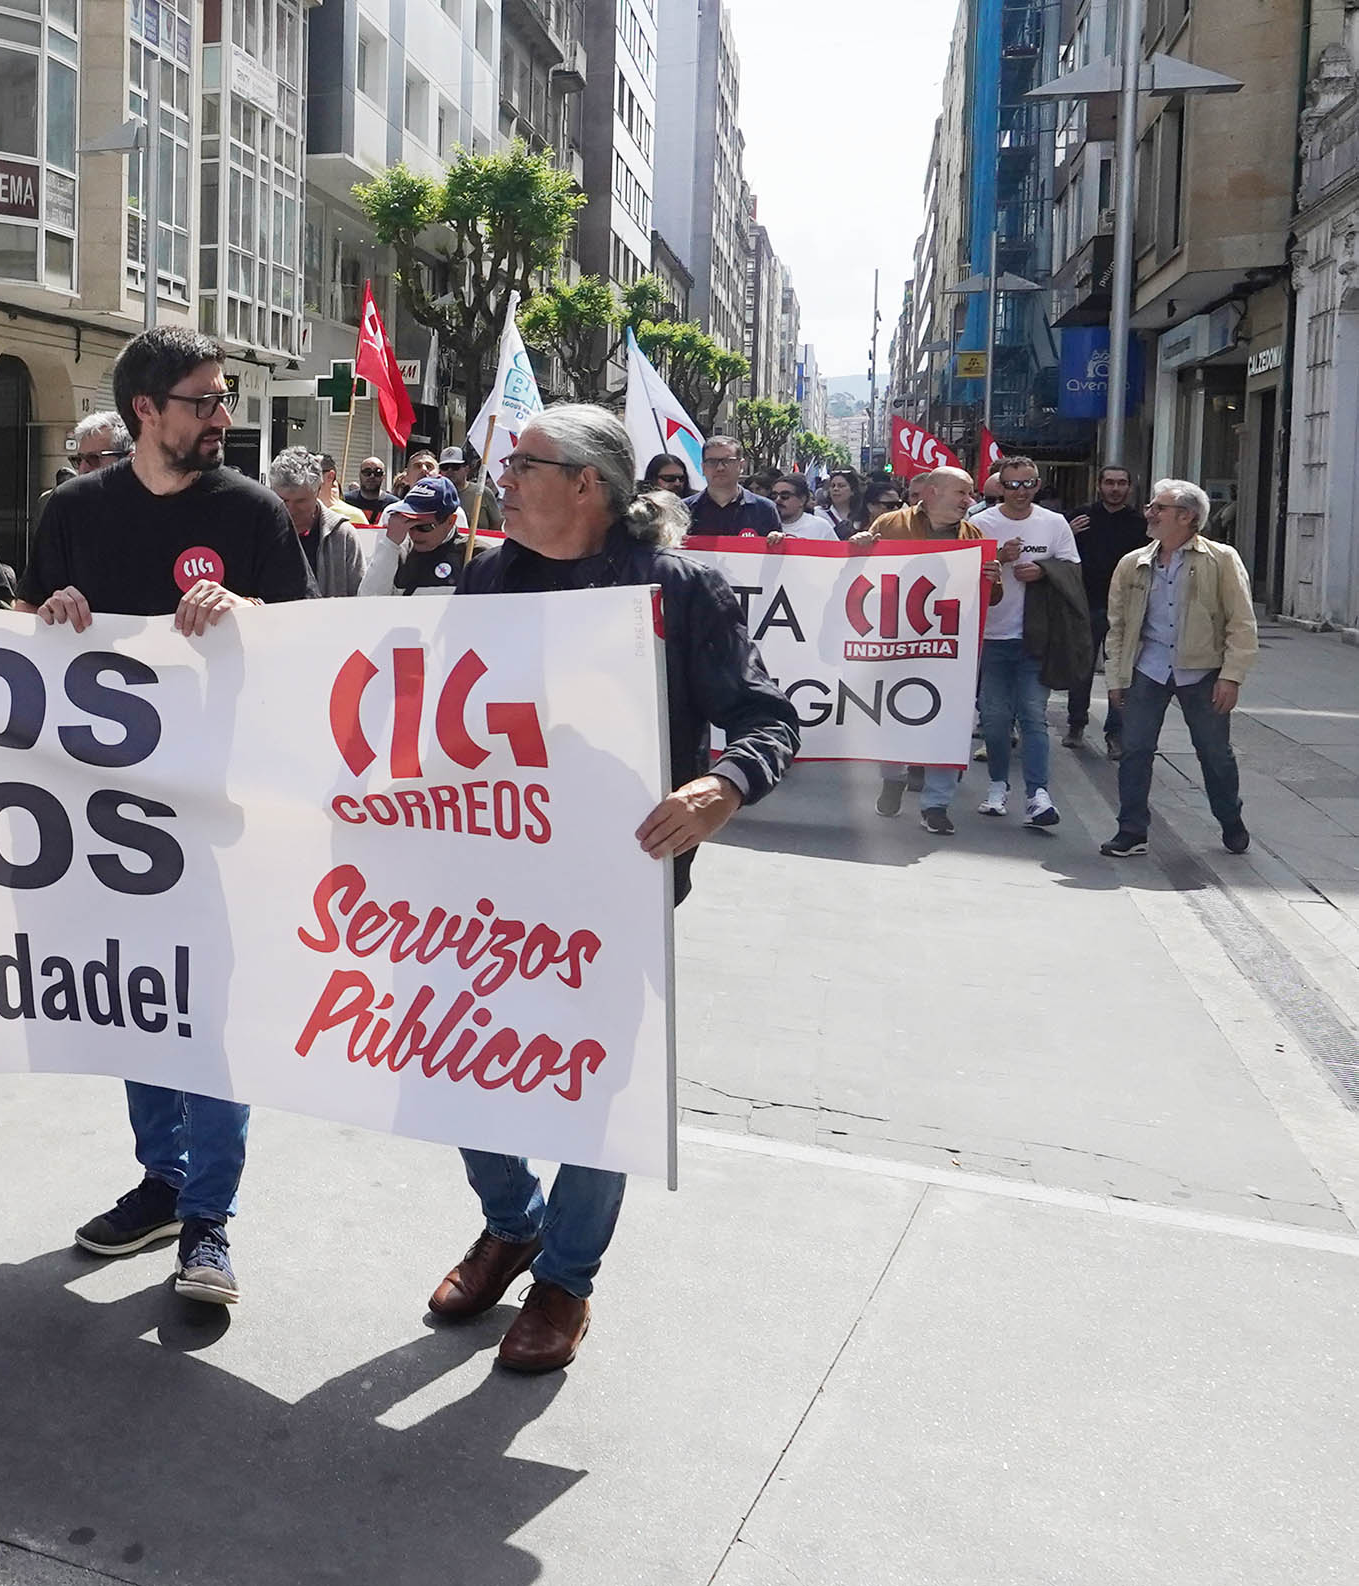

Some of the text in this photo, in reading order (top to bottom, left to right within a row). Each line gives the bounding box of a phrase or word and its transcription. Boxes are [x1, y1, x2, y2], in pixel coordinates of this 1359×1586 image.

[183, 557, 214, 577] CIG
[845, 574, 960, 639] CIG
[846, 640, 953, 658] INDUSTRIA
[329, 647, 549, 779] CIG
[772, 677, 942, 728] GNO
[331, 780, 552, 844] CORREOS
[297, 864, 602, 997] Servizos
[294, 969, 607, 1102] Públicos
